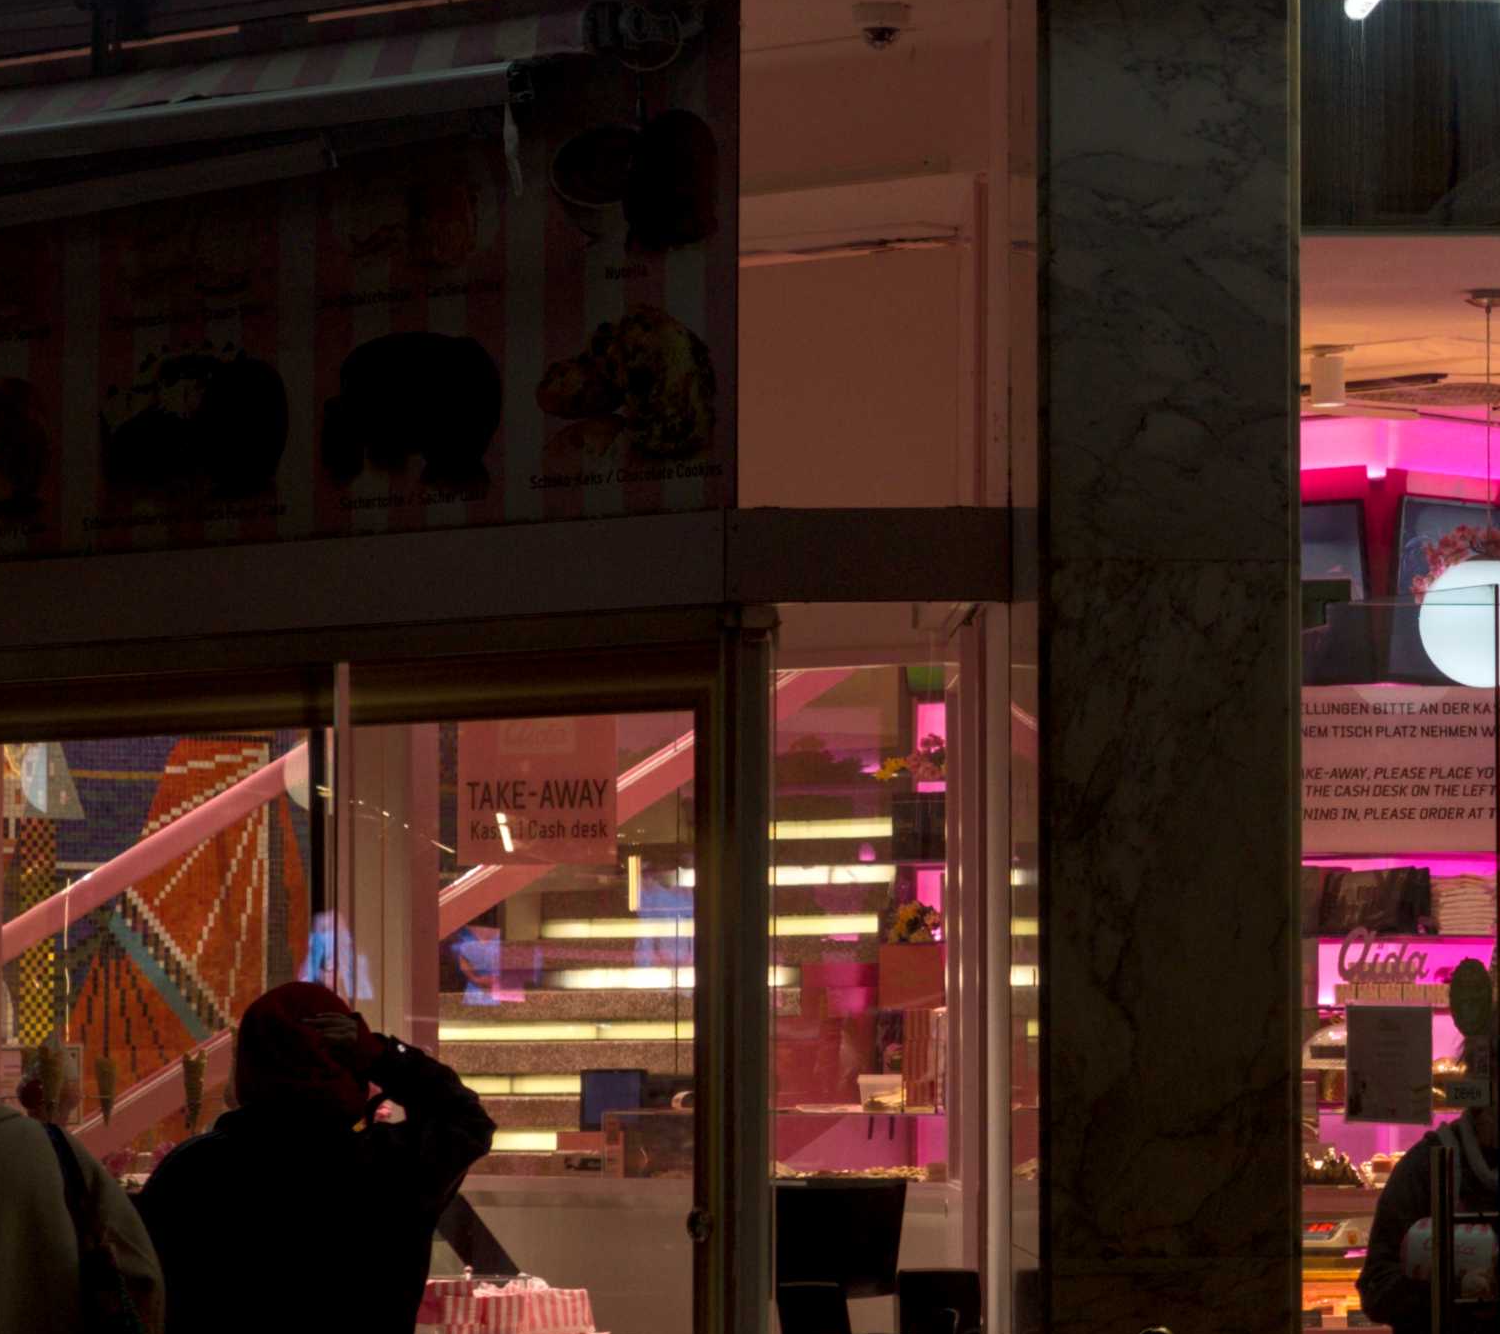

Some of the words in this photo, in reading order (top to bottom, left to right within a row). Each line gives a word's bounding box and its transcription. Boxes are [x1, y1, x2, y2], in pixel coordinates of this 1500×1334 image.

[1373, 702, 1417, 716] BITTE
[1420, 702, 1439, 715] AN
[1442, 702, 1470, 715] DER
[1332, 725, 1373, 738] TISCH
[1376, 725, 1417, 738] PLATZ
[1420, 725, 1478, 738] NEHMEN
[1373, 767, 1428, 780] PLEASE
[1429, 767, 1472, 780] PLACE
[466, 778, 609, 811] TAKE-AWAY
[1306, 784, 1332, 797] THE
[1334, 785, 1371, 798] CASH
[1372, 785, 1406, 797] DESK
[1411, 785, 1430, 797] ON
[1434, 785, 1460, 797] THE
[1364, 807, 1417, 820] PLEASE
[1419, 807, 1464, 820] ORDER
[1467, 807, 1485, 820] AT
[528, 819, 566, 841] Cash
[571, 818, 609, 840] desk
